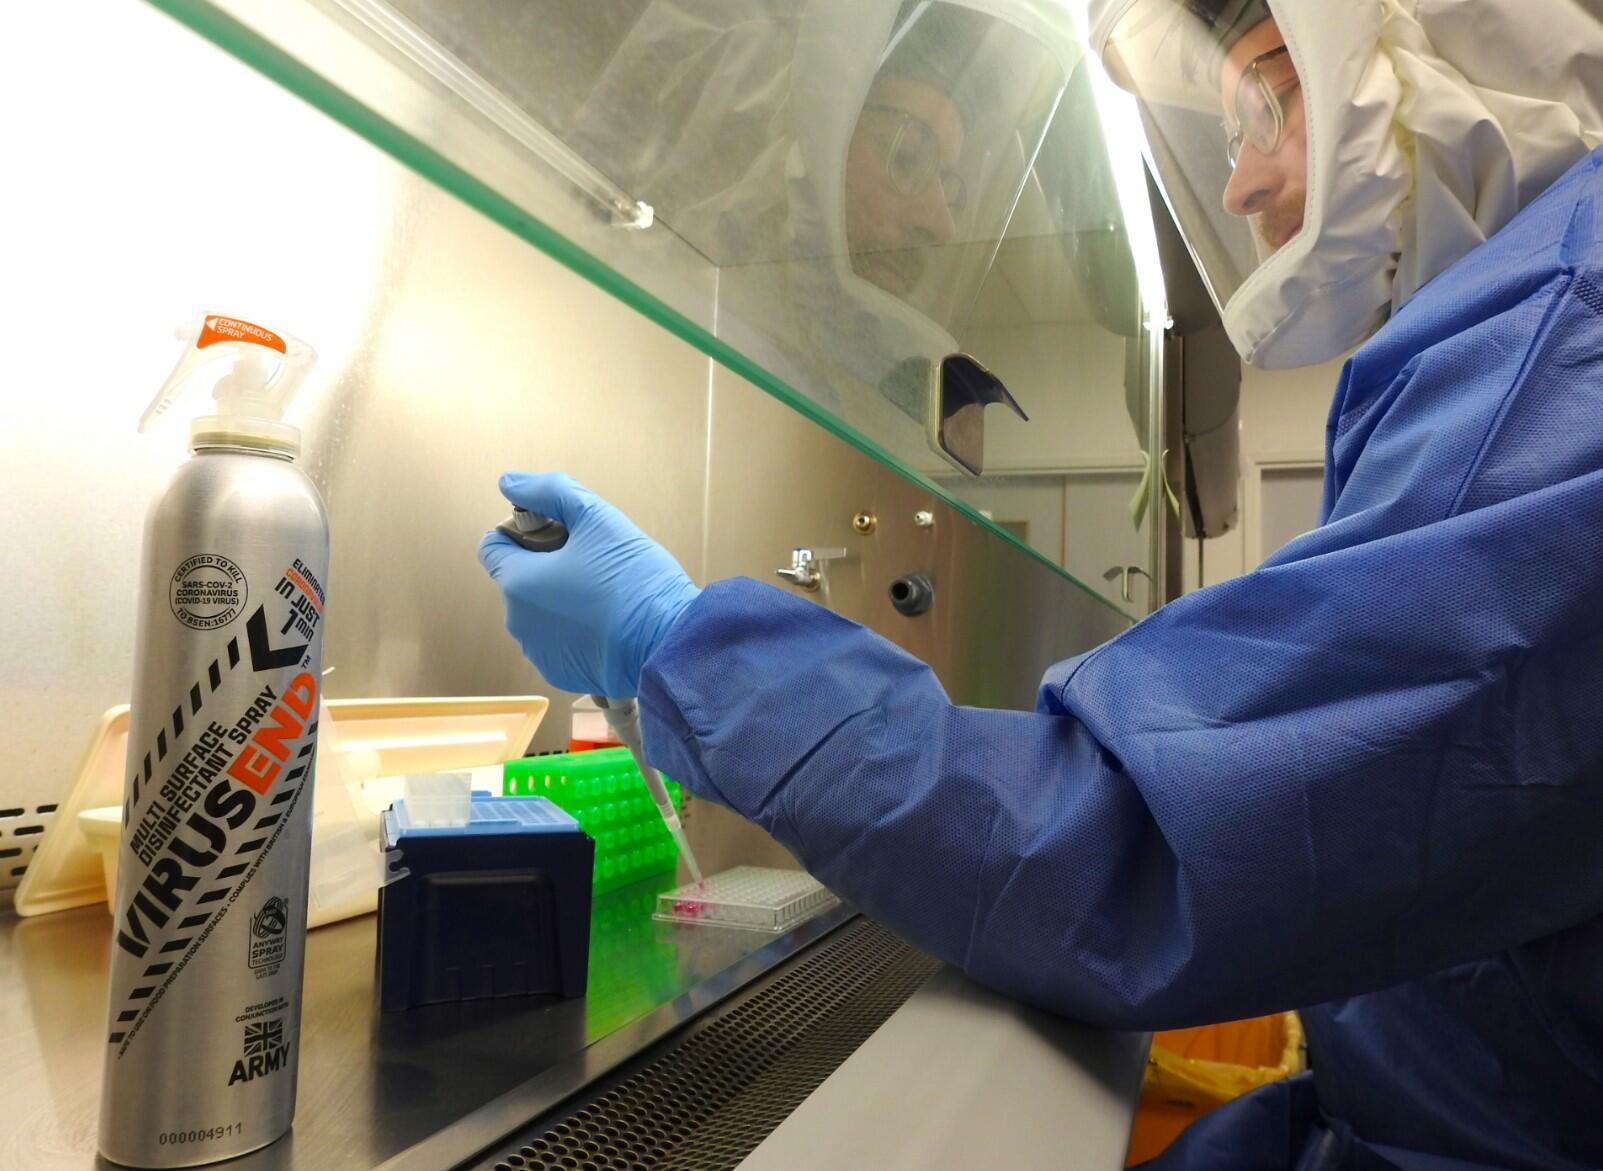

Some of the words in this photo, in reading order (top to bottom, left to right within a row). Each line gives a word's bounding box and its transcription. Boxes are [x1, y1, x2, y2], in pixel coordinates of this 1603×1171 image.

[216, 326, 245, 338] SPRAY
[218, 318, 272, 341] CONTINUOUS
[174, 556, 214, 583] CERTIFIED
[215, 557, 228, 568] TO
[227, 565, 243, 584] KILL
[176, 589, 239, 597] CORONAVIRUS
[181, 581, 233, 589] SARS-COV-2
[175, 597, 211, 606] (COVID-19
[212, 597, 239, 606] VIRUS)
[290, 594, 320, 628] JUST
[176, 607, 187, 620] TO
[280, 608, 299, 635] 1
[138, 742, 234, 867] DISINFECTANT
[227, 684, 278, 745] SPRAY
[129, 800, 166, 855] MULTI
[159, 721, 229, 800] SURFACE
[163, 942, 201, 989] PREPARATION
[198, 907, 228, 943] SURFACES
[229, 868, 257, 903] COMPLIES
[252, 936, 284, 949] ANYWAY
[252, 943, 284, 958] SPRAY
[228, 1041, 290, 1087] ARMY
[159, 1122, 243, 1145] 000004911
